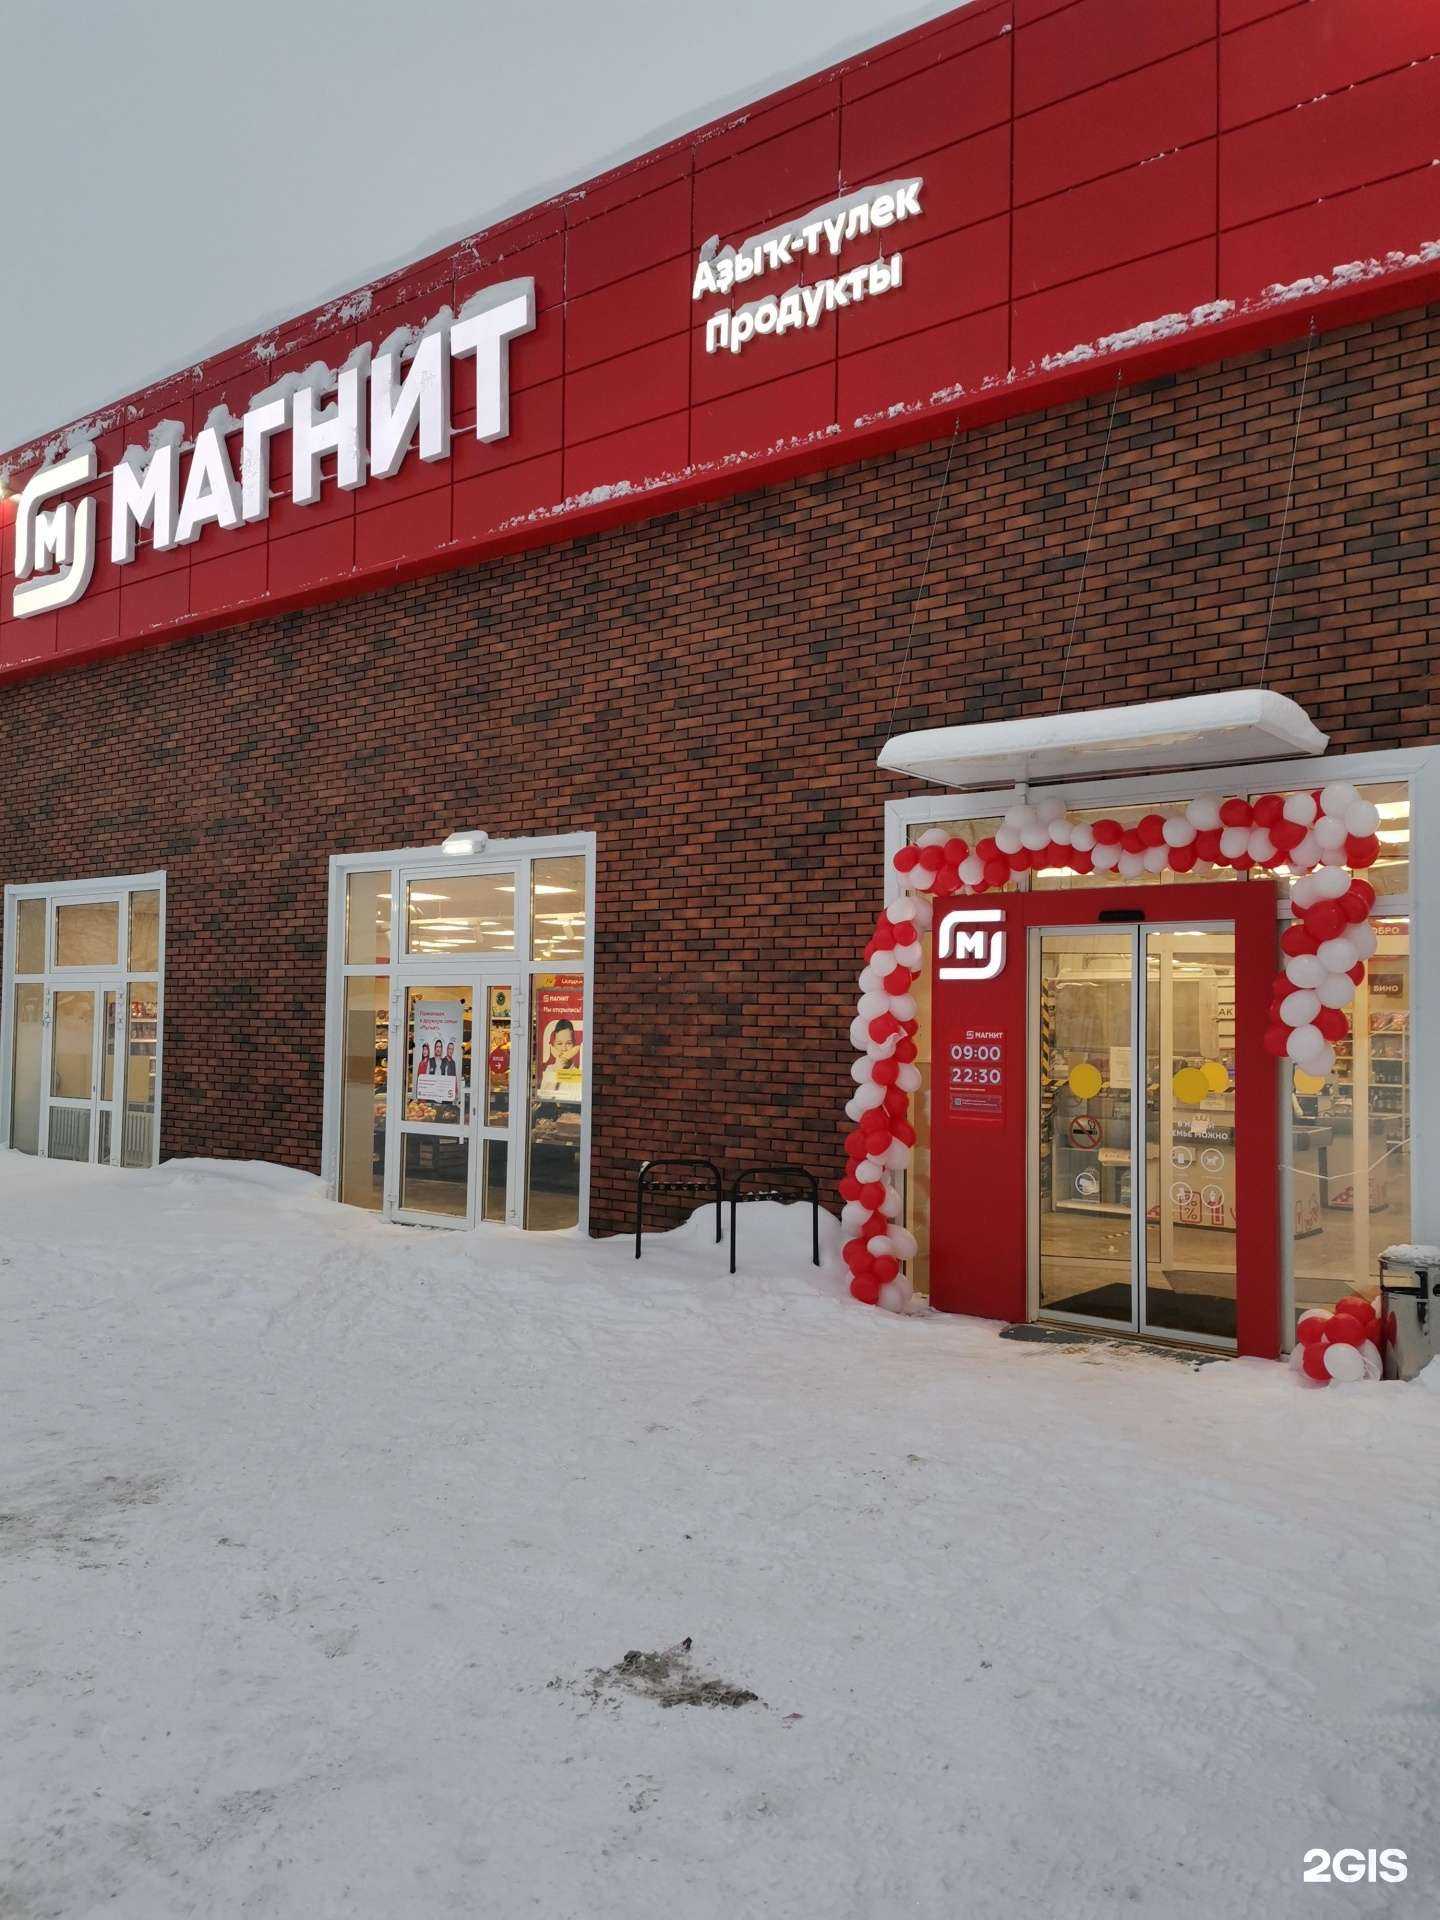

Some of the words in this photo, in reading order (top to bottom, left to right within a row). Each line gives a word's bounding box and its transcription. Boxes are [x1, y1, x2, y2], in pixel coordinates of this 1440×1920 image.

[706, 252, 902, 353] Продукты
[111, 292, 536, 565] МАГНИТ
[1373, 984, 1399, 992] ВИНО
[975, 1031, 1003, 1039] МАГНИТ
[951, 1045, 1001, 1060] 09:00
[952, 1068, 1001, 1084] 22:30
